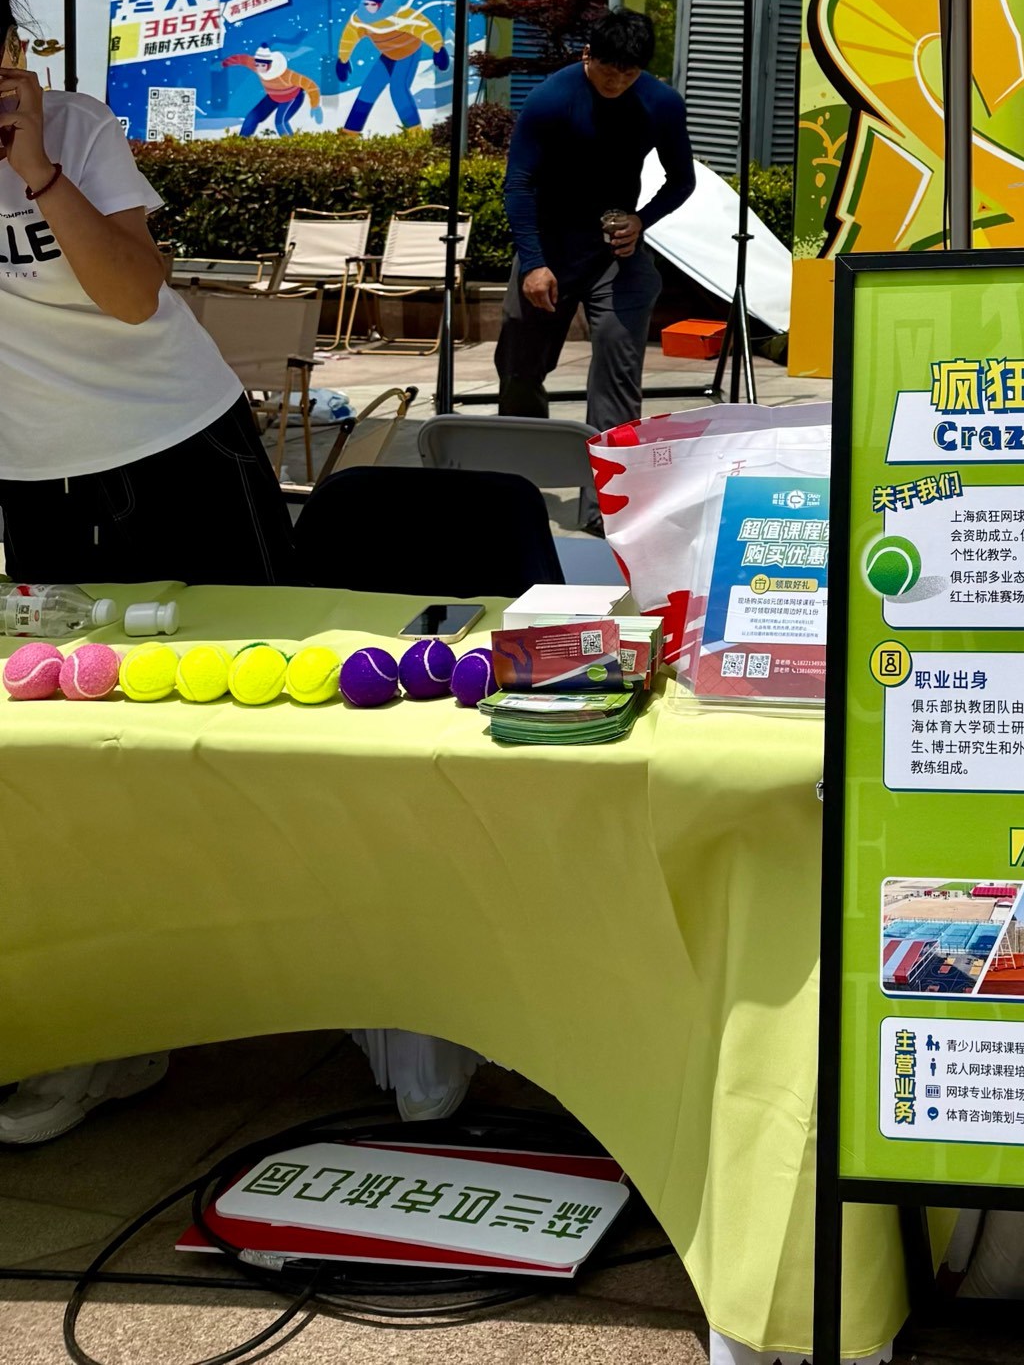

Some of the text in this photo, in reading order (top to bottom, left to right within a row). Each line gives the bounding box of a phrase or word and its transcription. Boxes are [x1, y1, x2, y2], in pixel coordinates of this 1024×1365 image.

[144, 8, 221, 39] 365天
[872, 470, 964, 512] 关于我们
[744, 544, 827, 566] 购买优惠
[950, 548, 1018, 562] 个性化教学。
[775, 579, 811, 590] 领取好礼
[915, 670, 988, 690] 职业出身
[911, 760, 969, 775] 教练组成。
[894, 1029, 916, 1124] 主营业务
[242, 1162, 602, 1239] 森兰匹克球公园
